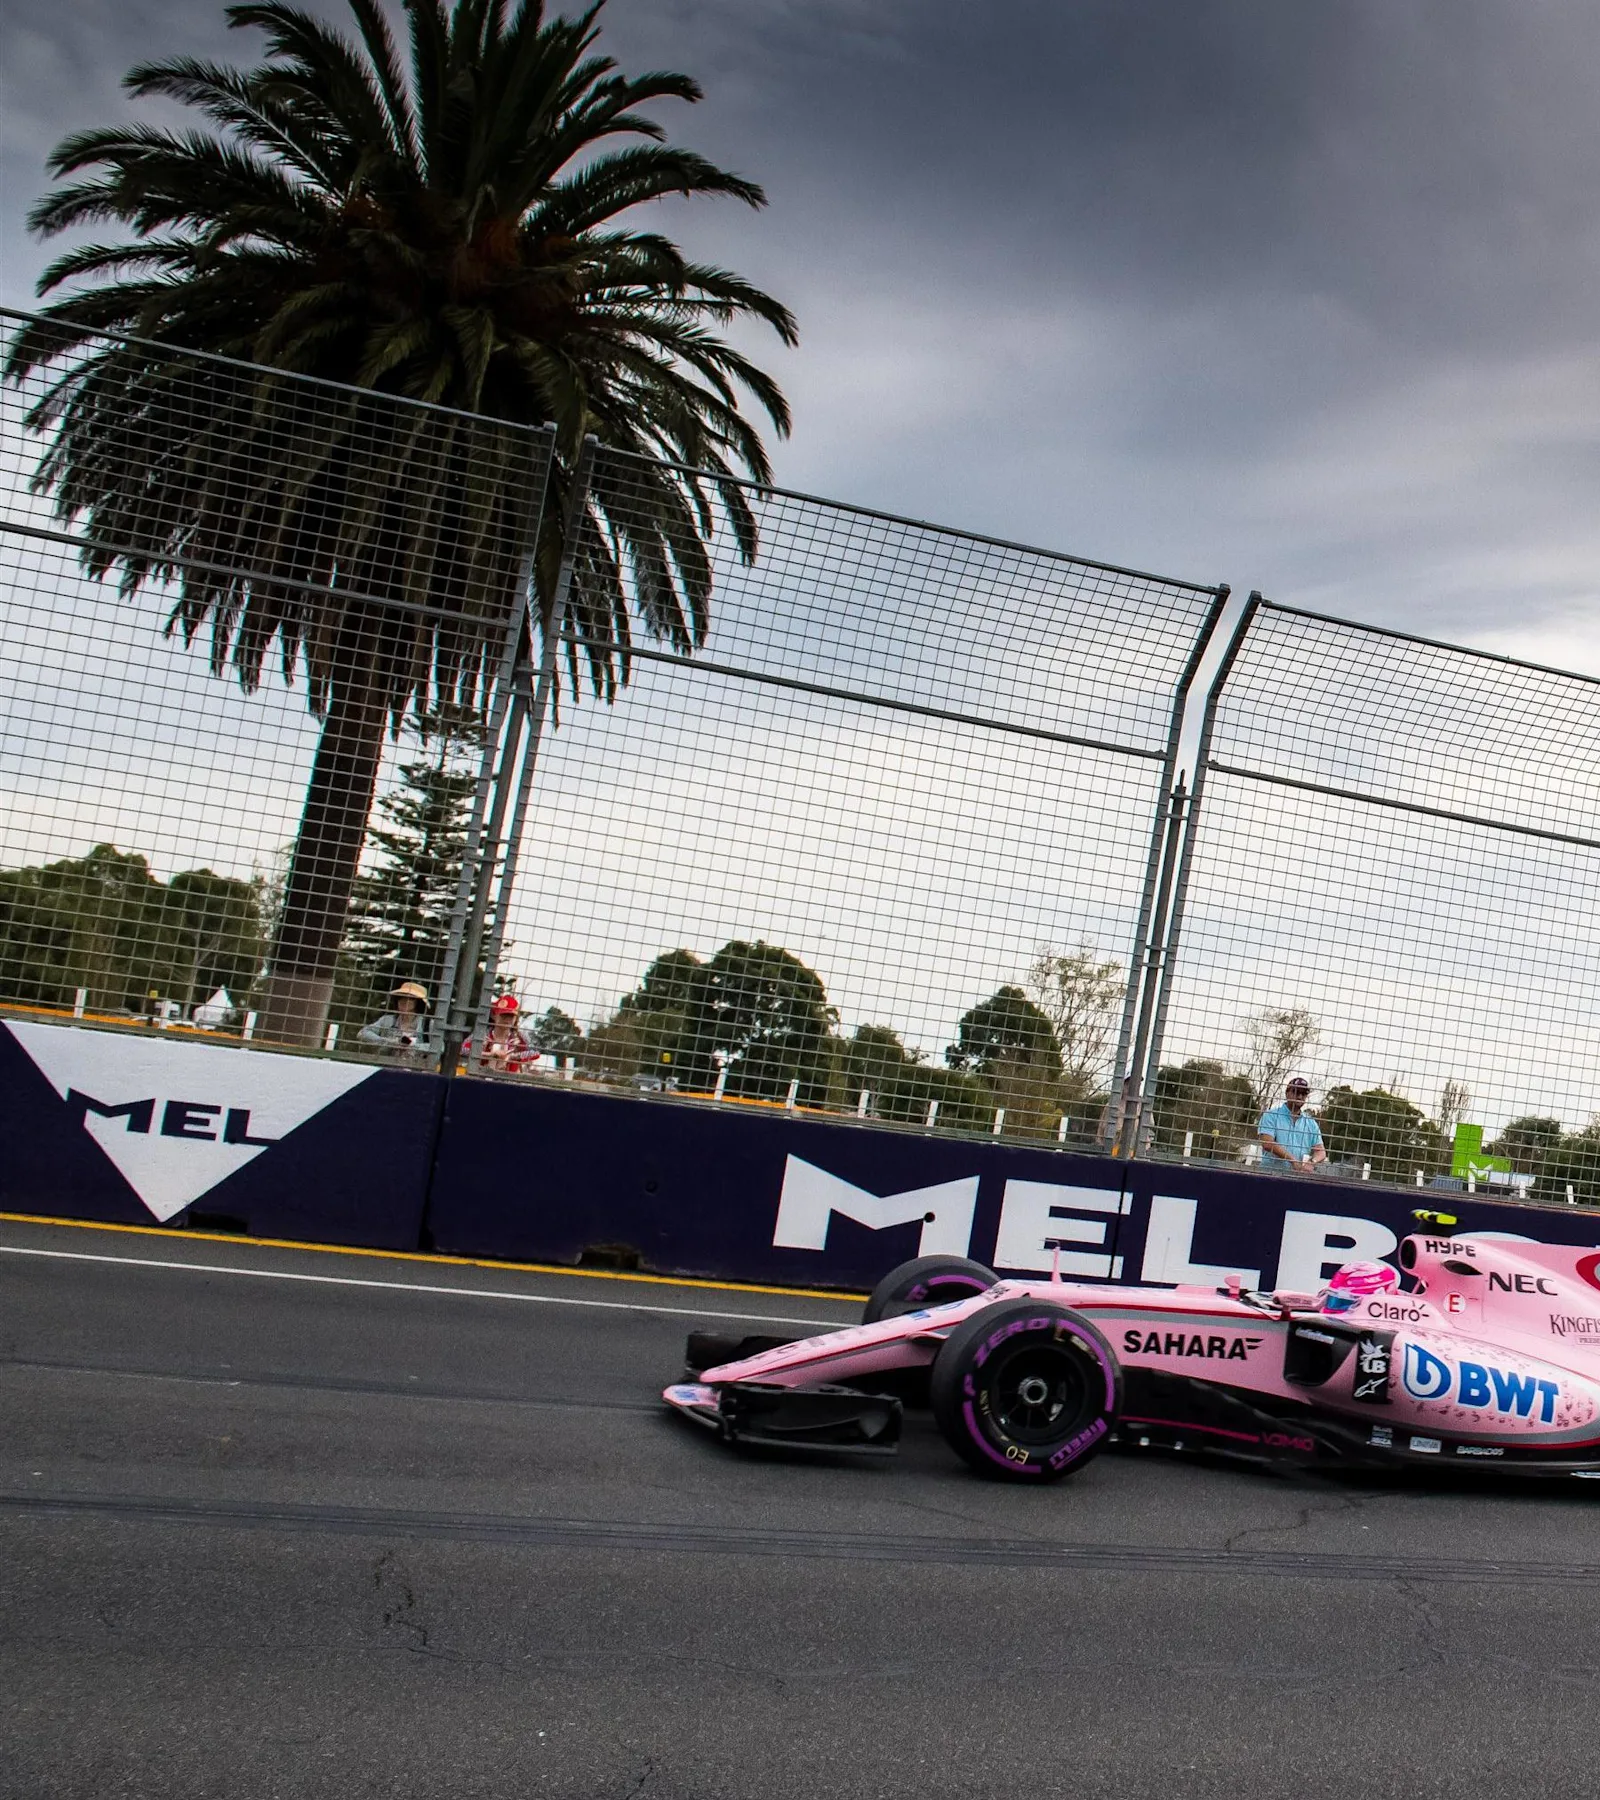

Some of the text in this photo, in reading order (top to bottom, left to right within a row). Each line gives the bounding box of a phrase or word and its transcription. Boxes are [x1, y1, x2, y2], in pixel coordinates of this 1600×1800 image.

[65, 1087, 282, 1148] MEL
[1425, 1240, 1477, 1258] HYPE
[1489, 1272, 1559, 1297] NEC
[1367, 1301, 1422, 1324] Claro
[1449, 1294, 1461, 1313] E
[973, 1317, 1050, 1369] ZERO
[1124, 1330, 1248, 1361] SAHARA
[1457, 1361, 1560, 1424] BWT
